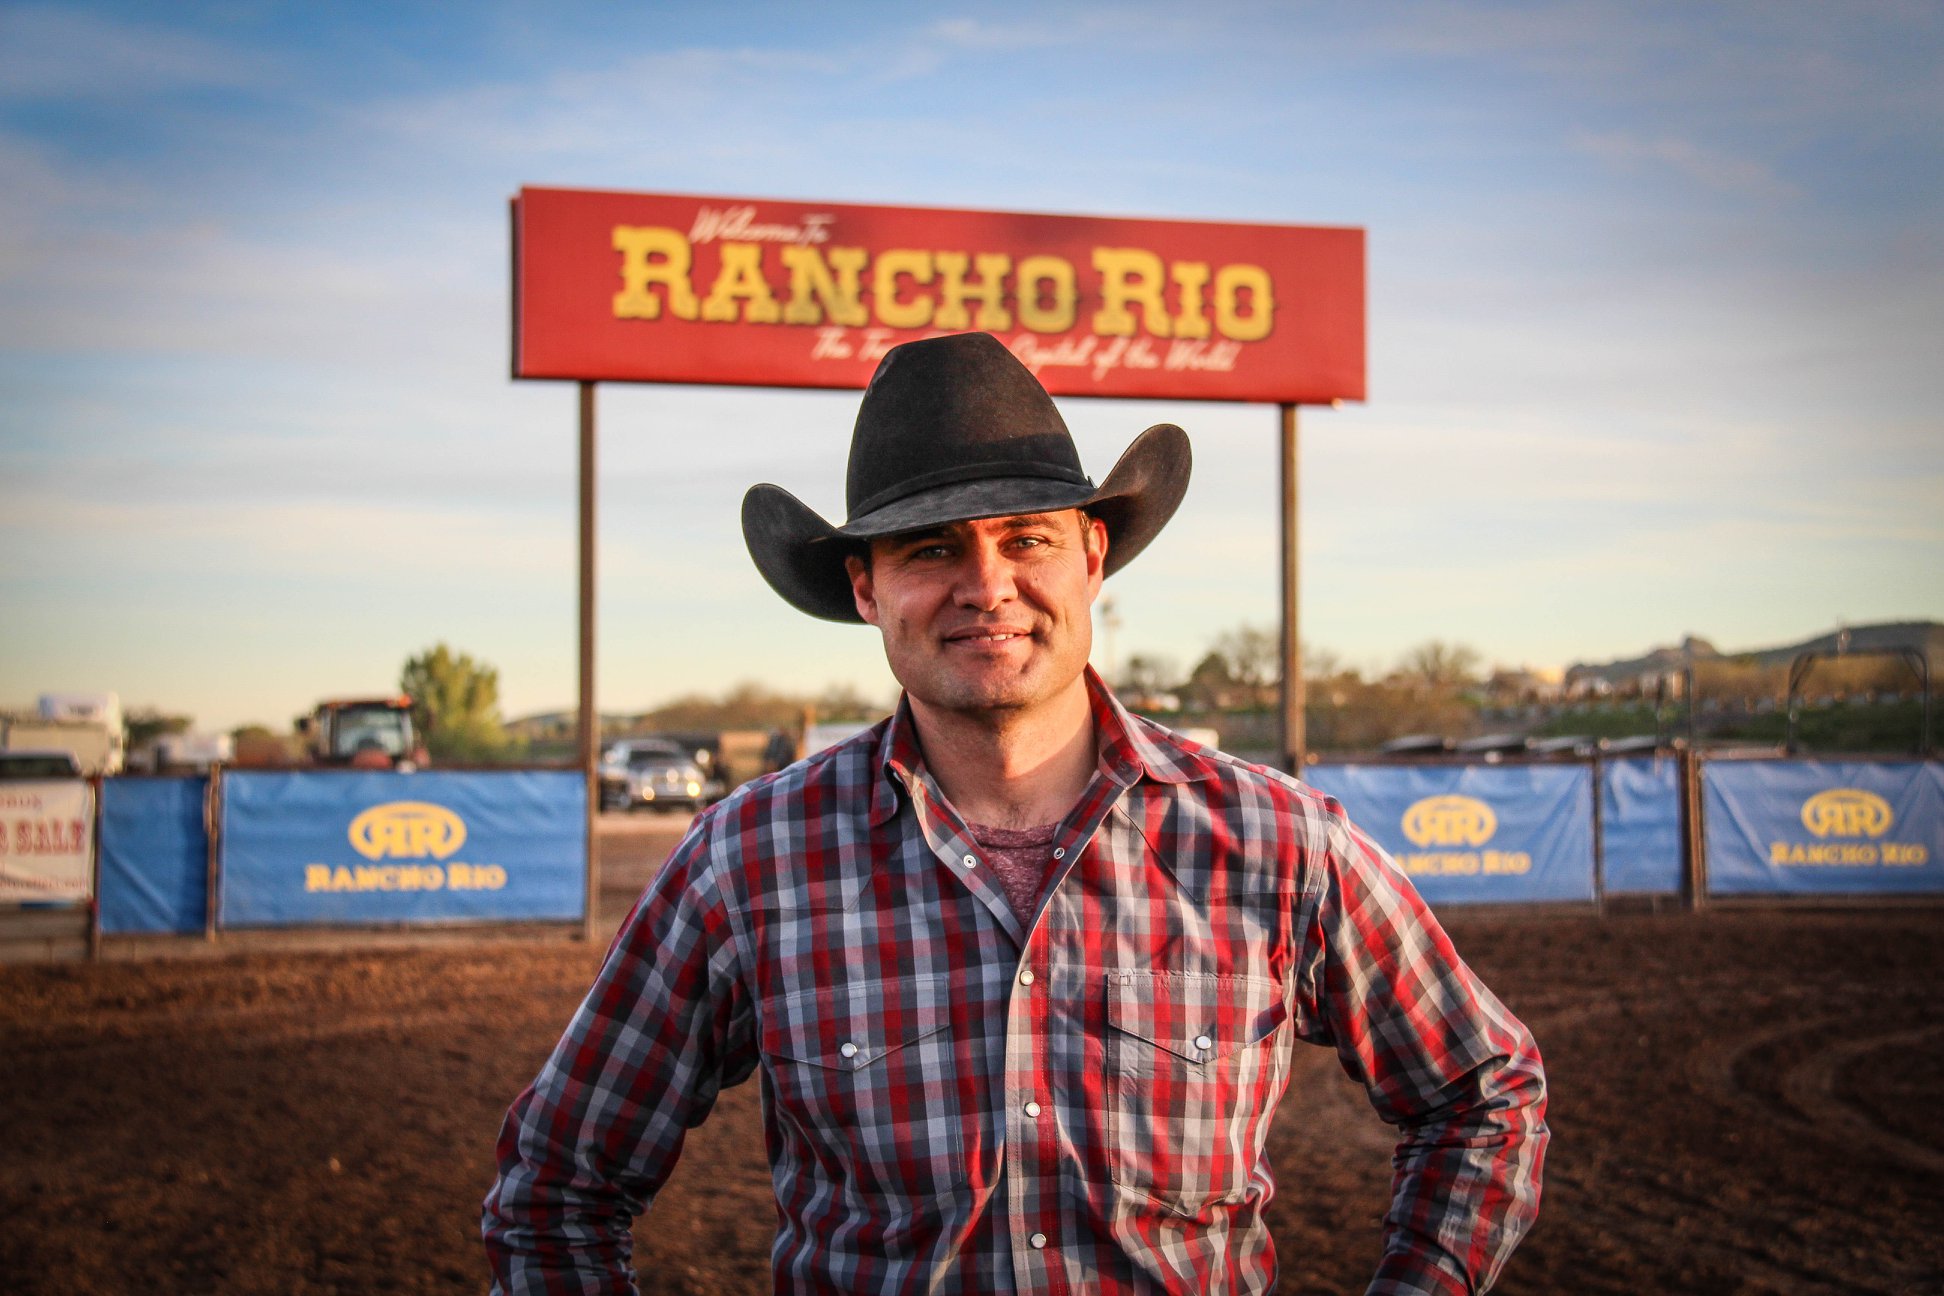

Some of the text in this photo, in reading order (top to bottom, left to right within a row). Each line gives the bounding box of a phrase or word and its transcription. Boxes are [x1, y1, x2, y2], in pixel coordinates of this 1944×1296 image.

[688, 205, 837, 247] Welcome To
[611, 225, 1275, 341] RANCHO RIO
[811, 326, 853, 361] The
[1092, 335, 1130, 381] of
[1123, 337, 1160, 369] the
[1163, 338, 1243, 372] World
[1393, 851, 1532, 876] ANCHO RIO
[1770, 841, 1929, 867] RANCHO RIO
[305, 861, 508, 892] RANCHO RIO
